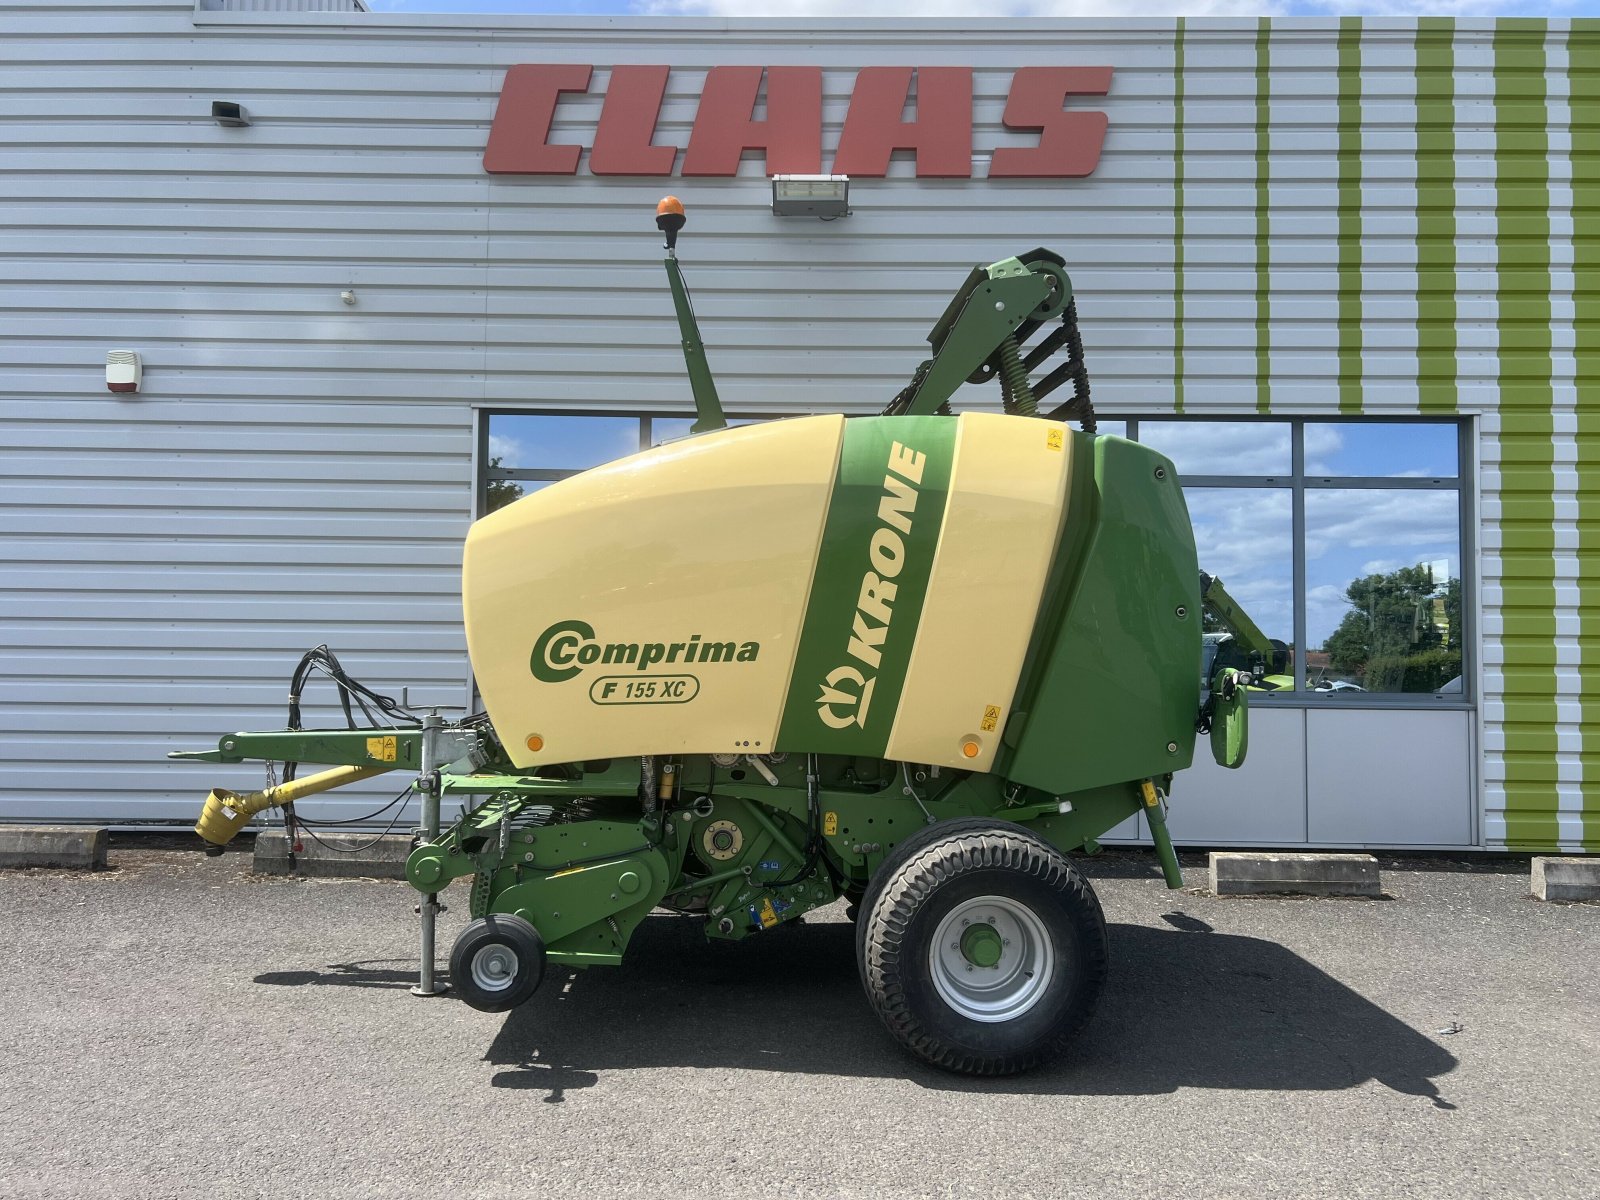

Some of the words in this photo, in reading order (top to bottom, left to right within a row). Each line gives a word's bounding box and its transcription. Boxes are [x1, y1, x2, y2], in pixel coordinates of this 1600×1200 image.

[484, 64, 1113, 177] CLAAS
[846, 440, 927, 670] KRONE
[530, 619, 760, 683] Comprima
[601, 682, 617, 699] F
[625, 681, 657, 699] 155
[660, 680, 686, 698] XC
